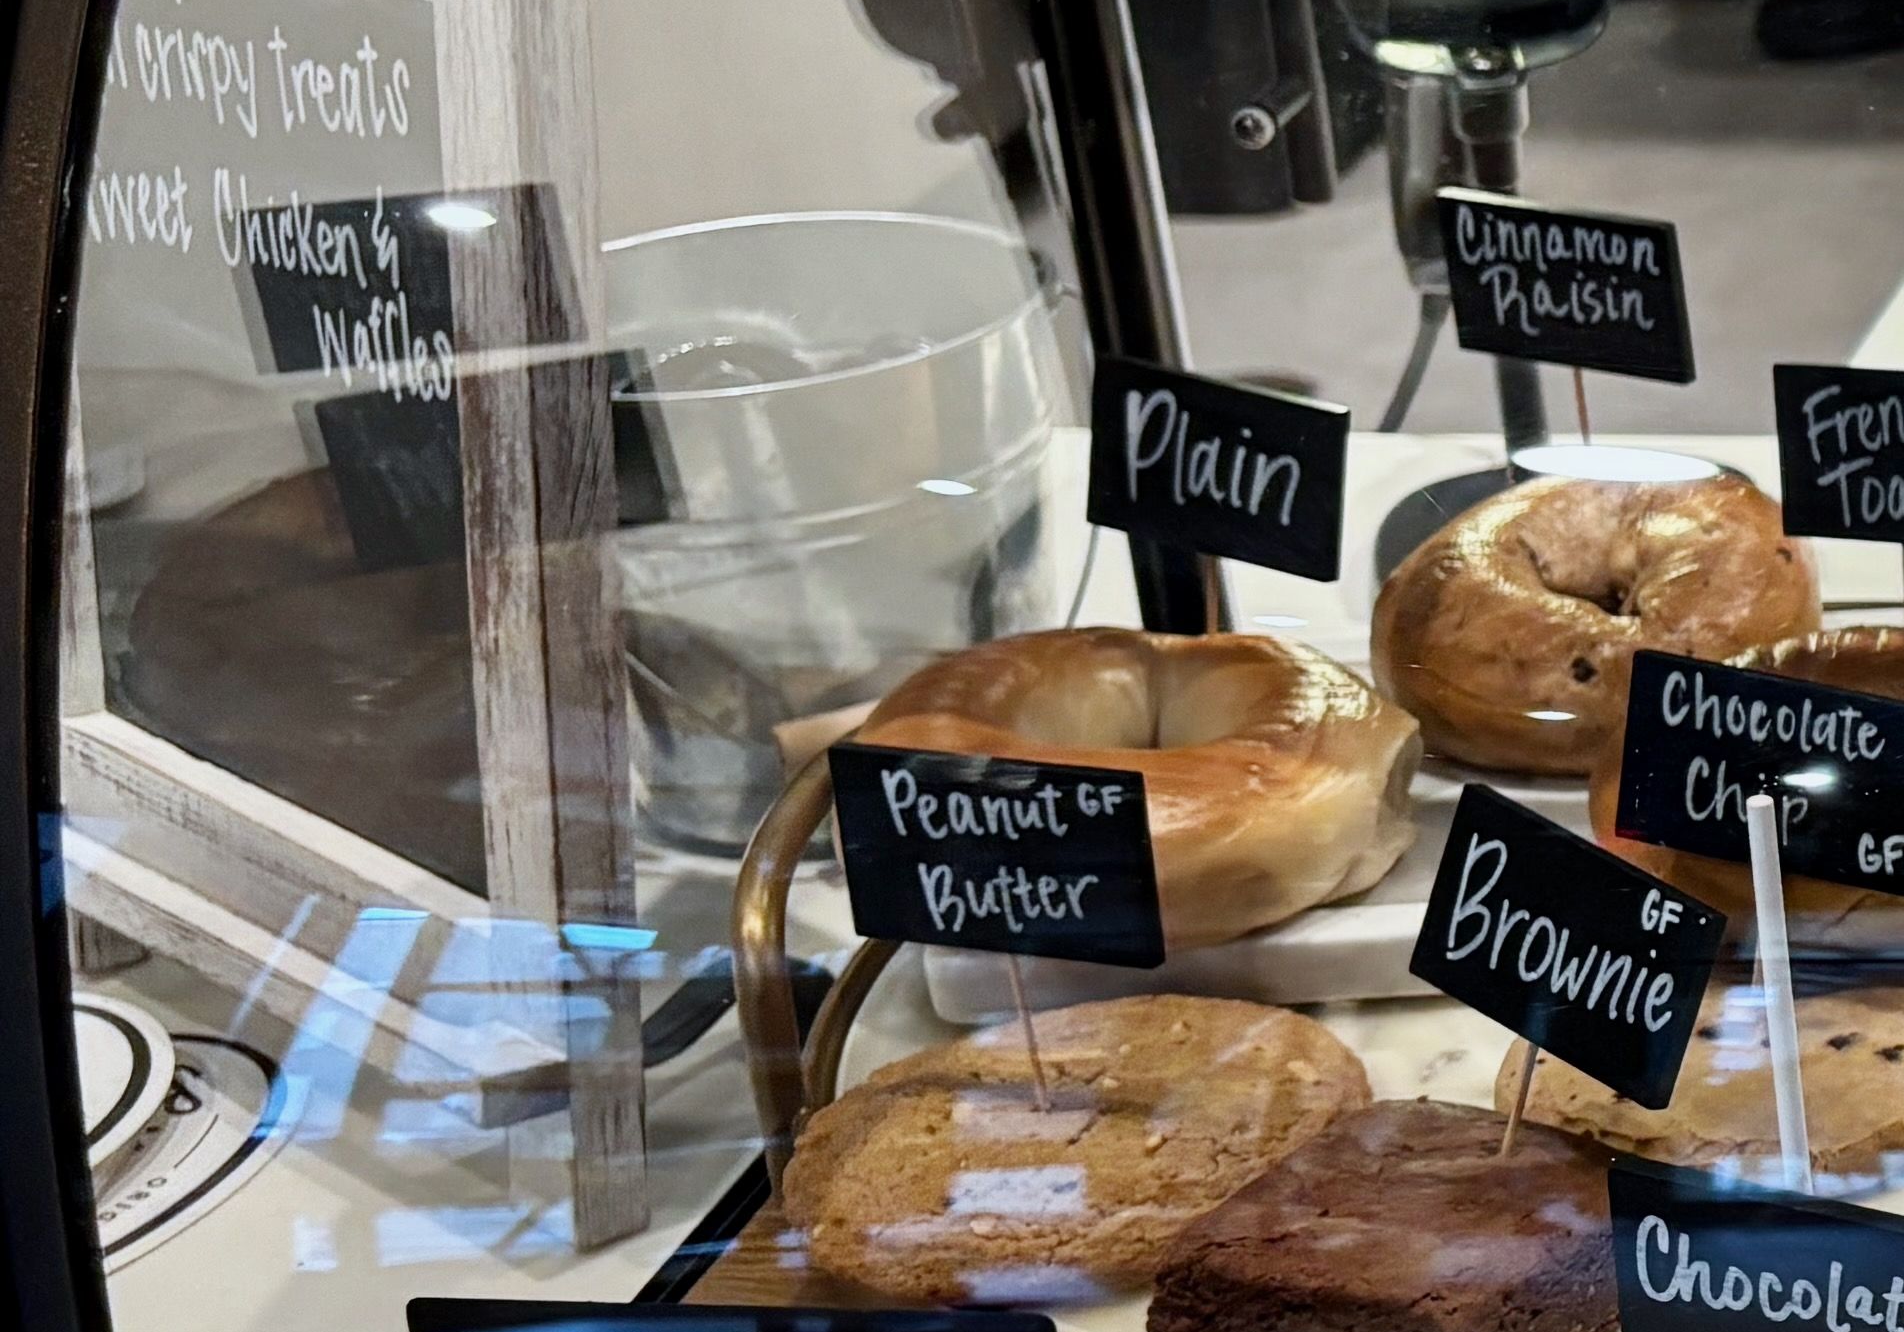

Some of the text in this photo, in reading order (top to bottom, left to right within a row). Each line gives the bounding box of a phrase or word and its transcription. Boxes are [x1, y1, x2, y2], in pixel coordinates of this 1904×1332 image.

[267, 25, 410, 139] treats
[213, 167, 367, 290] Chicken
[1455, 204, 1661, 277] Cinnamon
[1479, 265, 1654, 337] Raisin
[1125, 389, 1301, 526] Plain
[1661, 670, 1887, 762] Chocolate
[881, 768, 1125, 840] Peanut GF
[917, 862, 1100, 934] Butter
[1445, 832, 1676, 1034] Brownie
[1640, 888, 1684, 935] GF
